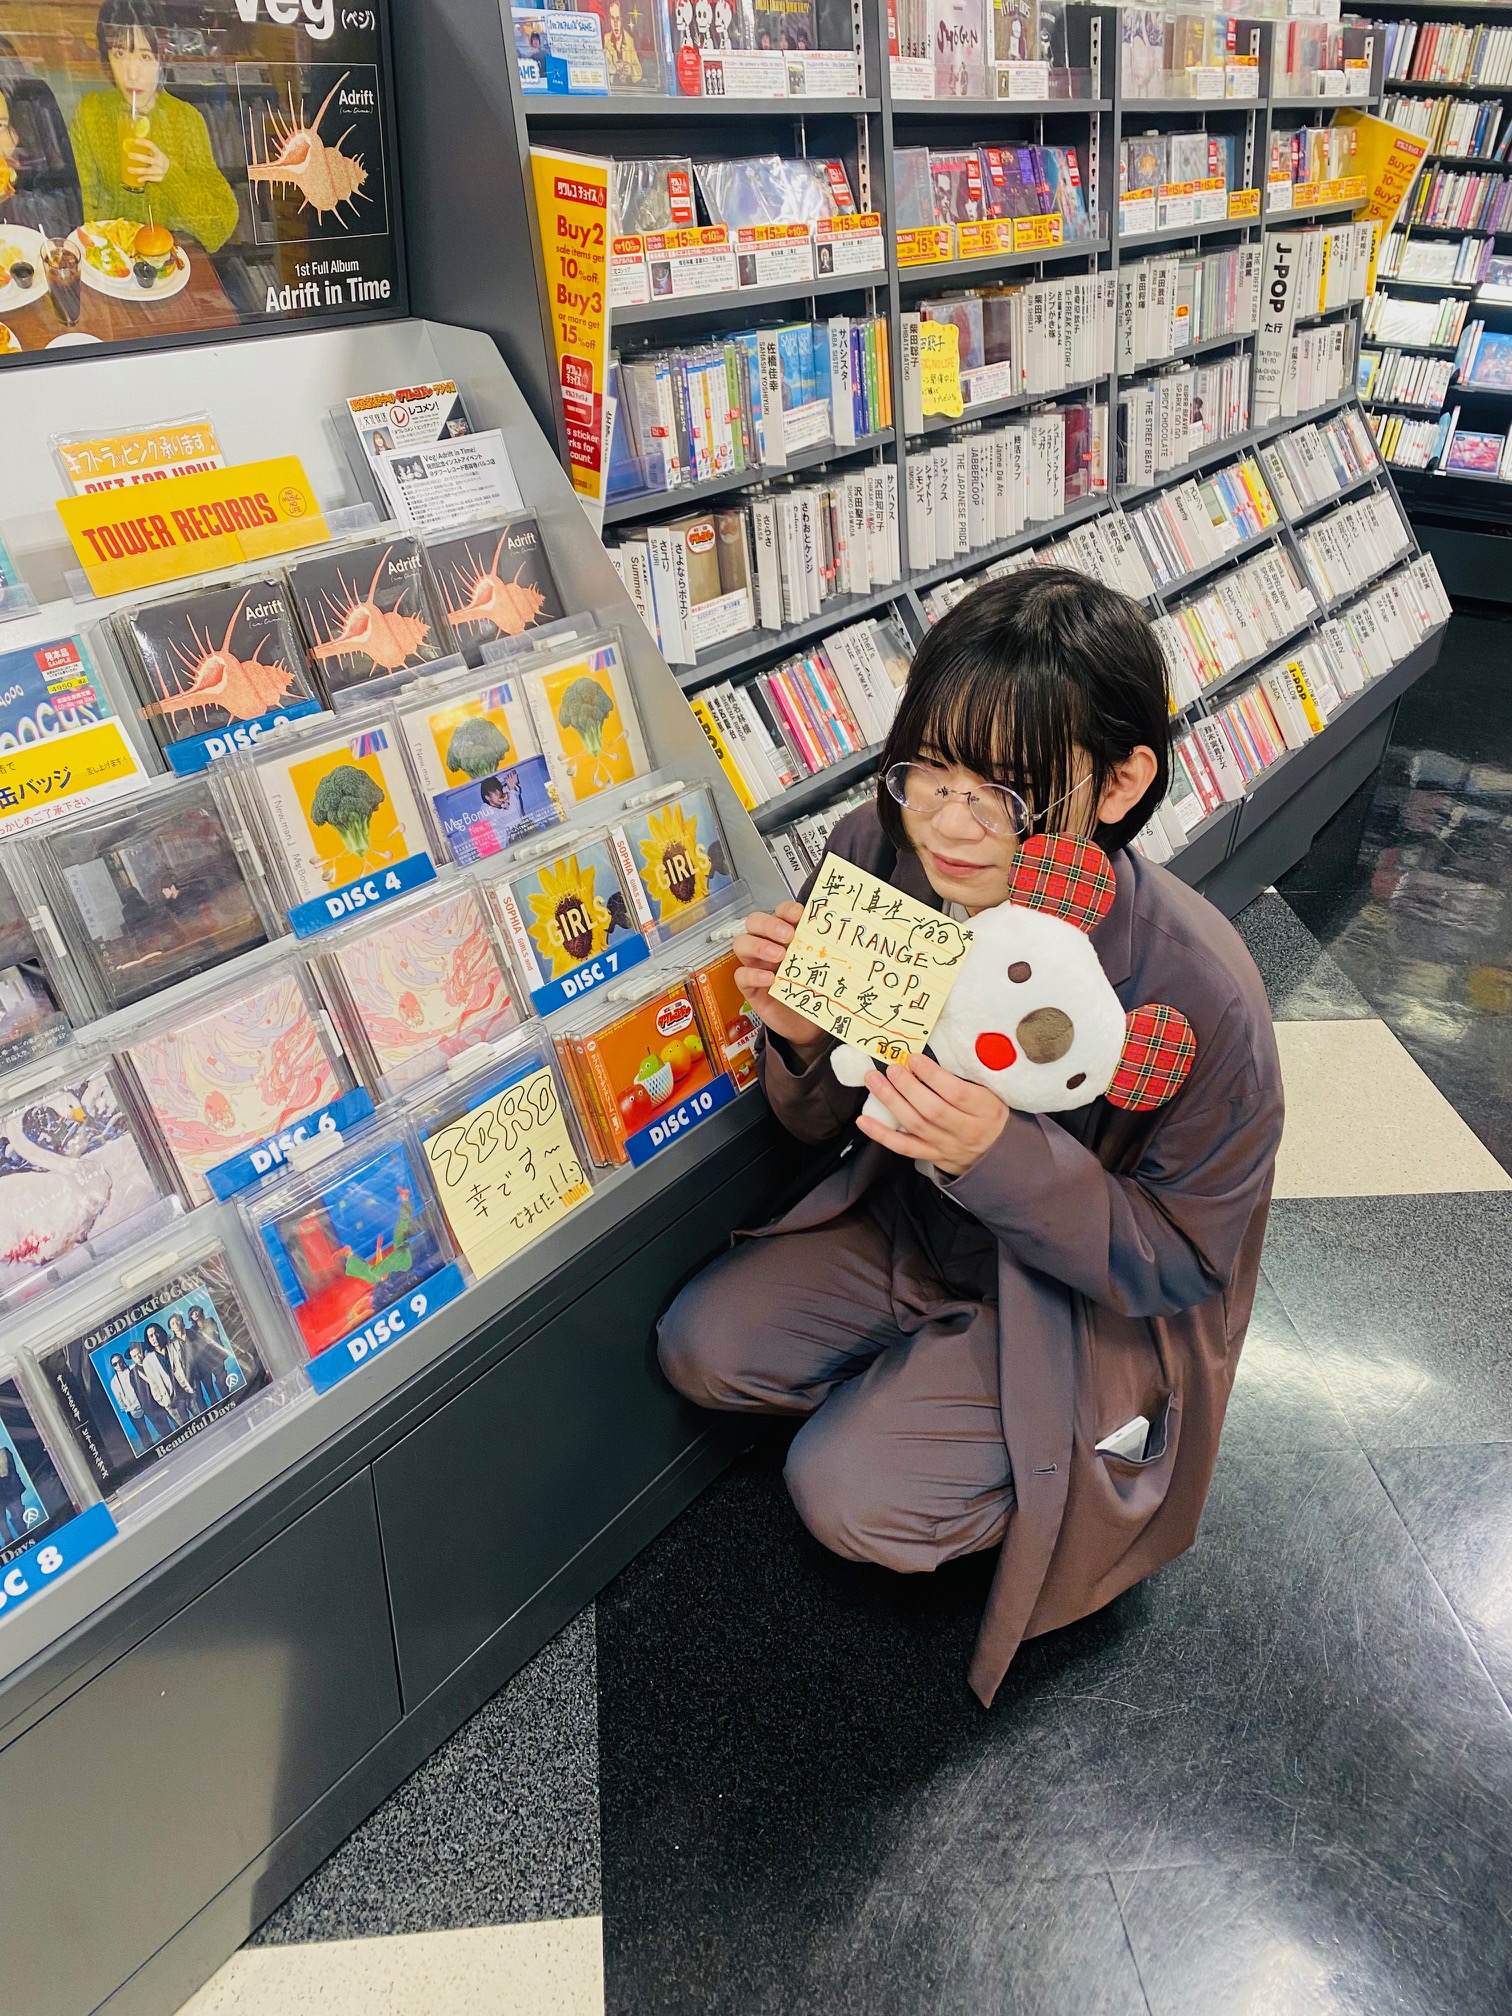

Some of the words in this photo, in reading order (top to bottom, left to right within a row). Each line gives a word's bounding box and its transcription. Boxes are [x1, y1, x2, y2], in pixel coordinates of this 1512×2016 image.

[339, 90, 374, 105] Adrift
[295, 263, 310, 277] 1st
[312, 261, 329, 275] Full
[330, 260, 359, 274] Album
[556, 244, 571, 255] sale
[571, 246, 591, 260] items
[592, 254, 605, 264] get
[1269, 242, 1292, 313] J-POP
[265, 282, 320, 313] Adrift
[325, 280, 342, 305] in
[347, 277, 391, 302] Time
[567, 315, 587, 326] more
[588, 319, 600, 330] get
[902, 323, 910, 352] SHIBATA
[1264, 323, 1283, 334] た行
[768, 343, 778, 391] 佐橋佳幸
[839, 328, 848, 391] サバシスター
[762, 376, 770, 415] YOSHIYUKI
[1145, 400, 1153, 415] THE
[1161, 387, 1169, 410] SPICY
[572, 430, 599, 444] sticker
[583, 442, 594, 453] for
[1038, 428, 1046, 459] シュガー
[1145, 418, 1153, 447] STREET
[1161, 412, 1169, 457] CHOCOLATE
[957, 453, 965, 470] THE
[971, 447, 980, 506] JABBERLOOP
[996, 470, 1004, 481] Da
[887, 474, 895, 520] サンハウス
[916, 466, 924, 503] シモンズ
[957, 473, 966, 519] JAPANESE
[996, 484, 1004, 497] Arc
[853, 486, 864, 530] 沢田聖子
[874, 478, 884, 532] 沢田知可子
[1175, 496, 1188, 521] Superfly
[81, 513, 175, 562] TOWER
[170, 492, 278, 543] RECORDS
[507, 532, 537, 550] Adrift
[763, 515, 772, 547] さらさ
[801, 502, 813, 573] さわおとケンジ
[959, 521, 967, 547] PRIDE
[1108, 522, 1125, 553] 湘南乃風
[1118, 518, 1131, 541] 女王蜂
[387, 554, 422, 575] Adrift
[651, 539, 659, 567] SAYURI
[660, 540, 669, 572] さユリ
[630, 556, 642, 600] Summer
[675, 543, 688, 631] さよならポエジー
[1252, 570, 1263, 591] SPECIAL
[1262, 591, 1273, 612] OTHERS
[1261, 566, 1273, 590] SPORTS
[1271, 590, 1280, 604] MEN
[1272, 573, 1291, 611] SPELLBOUND
[245, 598, 285, 622] Adrift
[44, 646, 70, 663] 見本品
[860, 632, 876, 659] chef's
[47, 656, 71, 668] SAMPLE
[51, 682, 73, 692] 4950
[1268, 679, 1279, 701] SLACK
[1281, 670, 1298, 701] SWALLOW
[1296, 660, 1306, 680] SEKAI
[1308, 687, 1319, 708] OWARI
[720, 694, 735, 720] SHEENA
[733, 720, 746, 742] RINGO
[726, 692, 752, 735] 椎名林檎
[801, 832, 810, 844] THE
[655, 843, 712, 890] GIRLS
[783, 844, 800, 872] GEMN
[616, 840, 633, 876] SOPHIA
[629, 878, 641, 901] GIRLS
[635, 898, 643, 911] and
[324, 880, 380, 919] DISC
[384, 871, 401, 891] 4
[503, 896, 522, 935] SOPHIA
[517, 937, 529, 960] GIRLS
[524, 958, 534, 972] and
[546, 895, 612, 948] GIRLS
[561, 963, 606, 999] DISC
[605, 952, 619, 972] 7
[648, 1109, 690, 1147] DISC
[691, 1092, 713, 1116] 10
[249, 1124, 309, 1174] DISC
[318, 1112, 336, 1134] 6
[74, 1163, 107, 1188] Blood
[83, 1270, 204, 1351] OLEDICKFOGGY
[347, 1310, 406, 1363] DISC
[410, 1294, 428, 1318] 9
[155, 1416, 210, 1460] Beautiful
[208, 1400, 236, 1425] Days
[37, 1544, 63, 1576] 8
